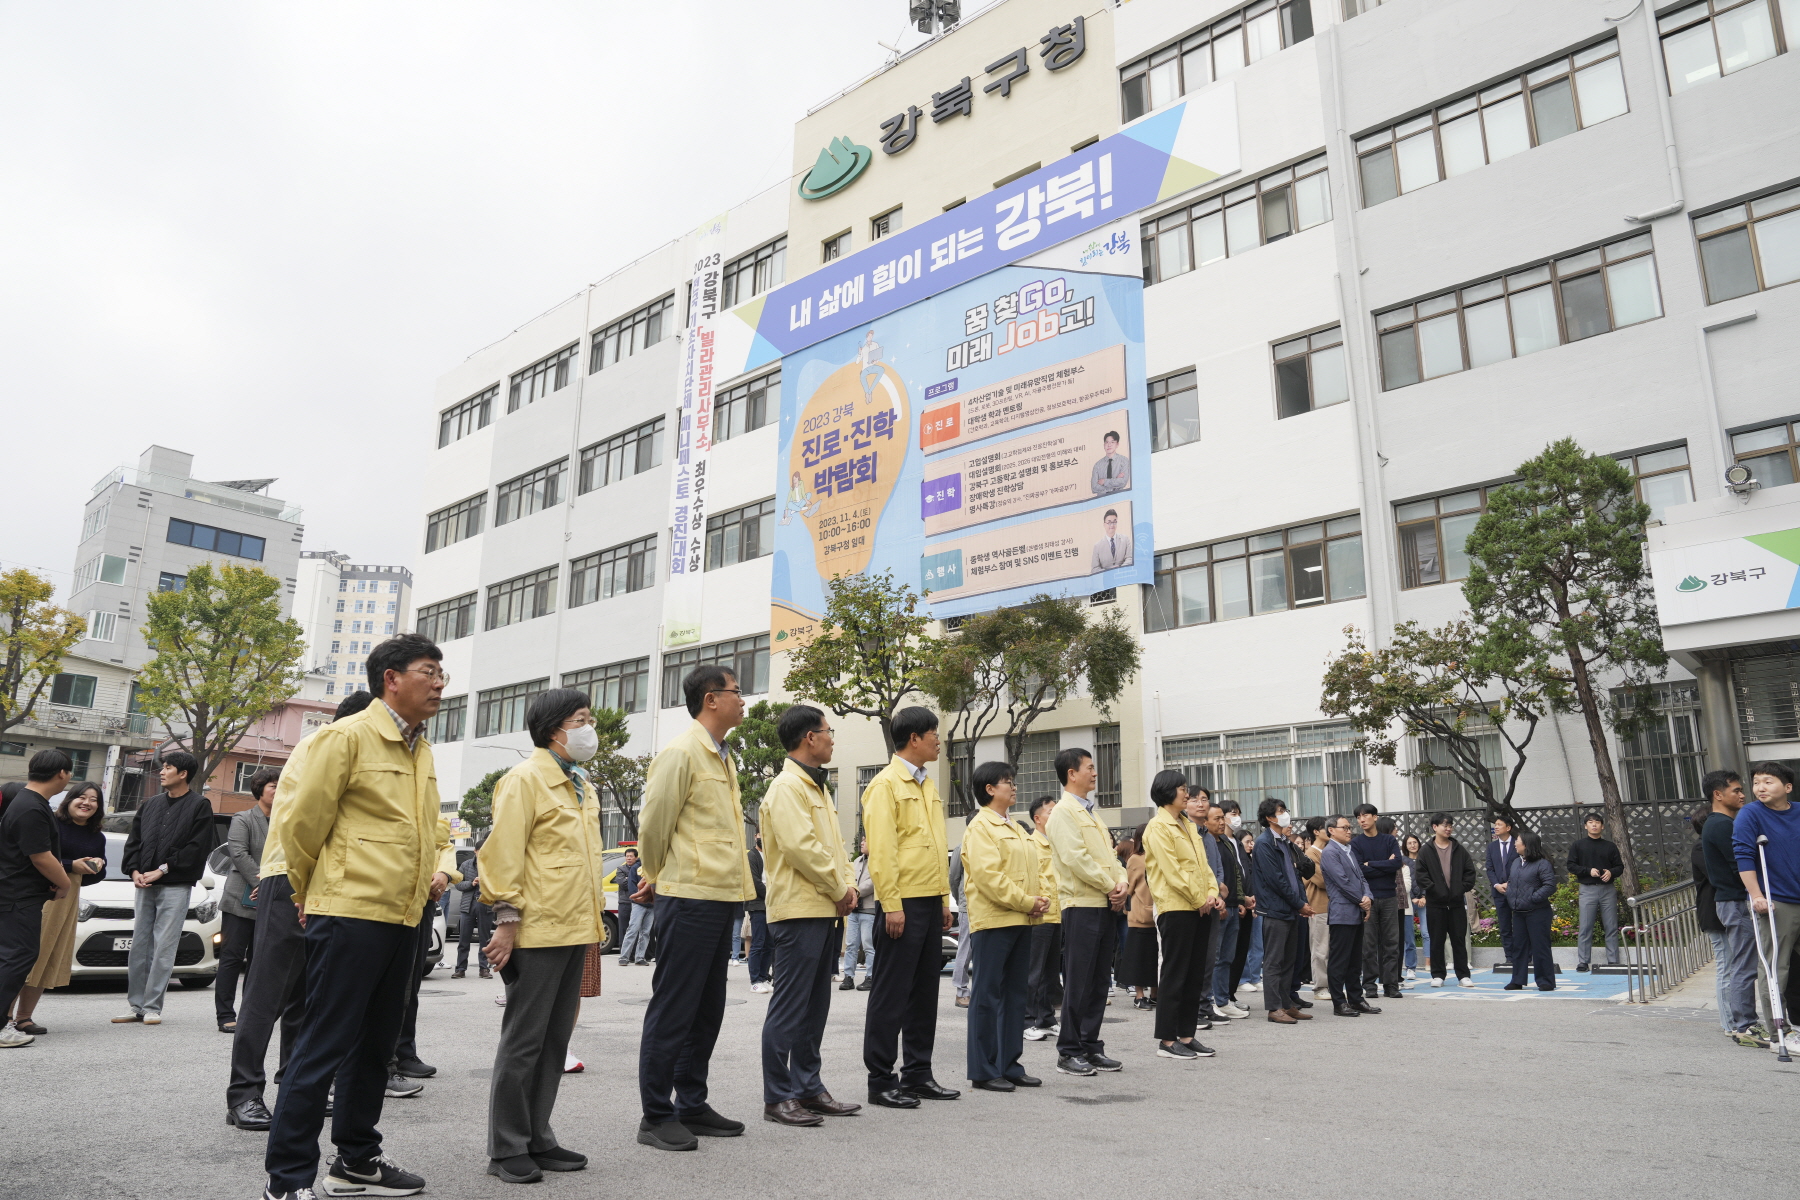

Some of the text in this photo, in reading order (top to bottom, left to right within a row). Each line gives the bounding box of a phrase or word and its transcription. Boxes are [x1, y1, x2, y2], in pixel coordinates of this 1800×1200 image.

[880, 15, 1087, 155] 강북구청
[789, 152, 1113, 332] 내 삶에 힘이 되는 강북!
[1103, 231, 1130, 255] 강북
[702, 271, 719, 319] 강북구
[947, 296, 1094, 372] 미래 Job고!
[965, 303, 988, 336] 꿈
[928, 381, 954, 396] 프로그램
[968, 365, 1086, 406] 4차산업기술 및 미래유망직업 체험부스
[803, 402, 854, 434] 2023 강북
[968, 402, 1023, 425] 대학생 학과 멘토링
[676, 414, 691, 499] 매니페스토
[814, 451, 877, 498] 박람회
[969, 457, 1078, 491] 강북구 고등학교 설명회 및 홍보부스
[692, 460, 705, 530] 최우수상
[969, 481, 1024, 502] 장애학생 진학상담
[819, 517, 838, 529] 2023.
[840, 514, 850, 522] 11.
[819, 518, 870, 541] 10:00~16:00
[672, 505, 688, 574] 경진대회
[689, 537, 700, 572] 수상
[824, 536, 865, 556] 강북구청 일대
[970, 552, 990, 565] 중학생
[971, 547, 1079, 576] 체험부스 참여 및 SNS 이벤트 진행
[1711, 566, 1766, 586] 강북구
[790, 625, 813, 637] 강북구
